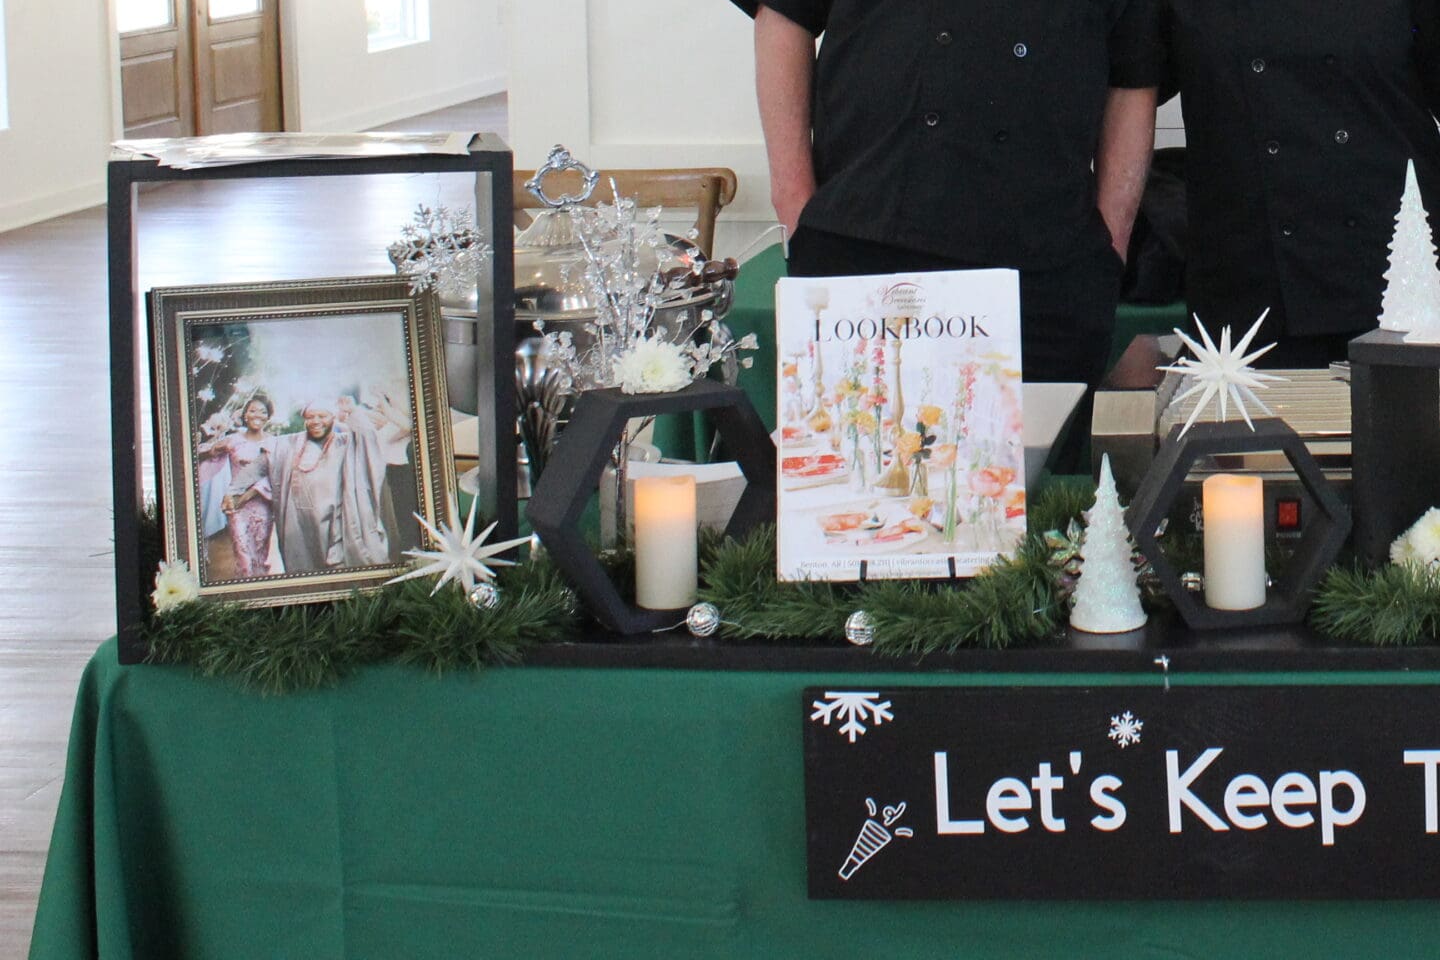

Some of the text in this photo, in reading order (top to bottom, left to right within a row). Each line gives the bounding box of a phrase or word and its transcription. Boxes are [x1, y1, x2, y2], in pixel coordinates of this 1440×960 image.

[814, 316, 990, 342] LOOKBOOK
[934, 749, 1128, 834] Let's
[1165, 747, 1366, 846] Keep
